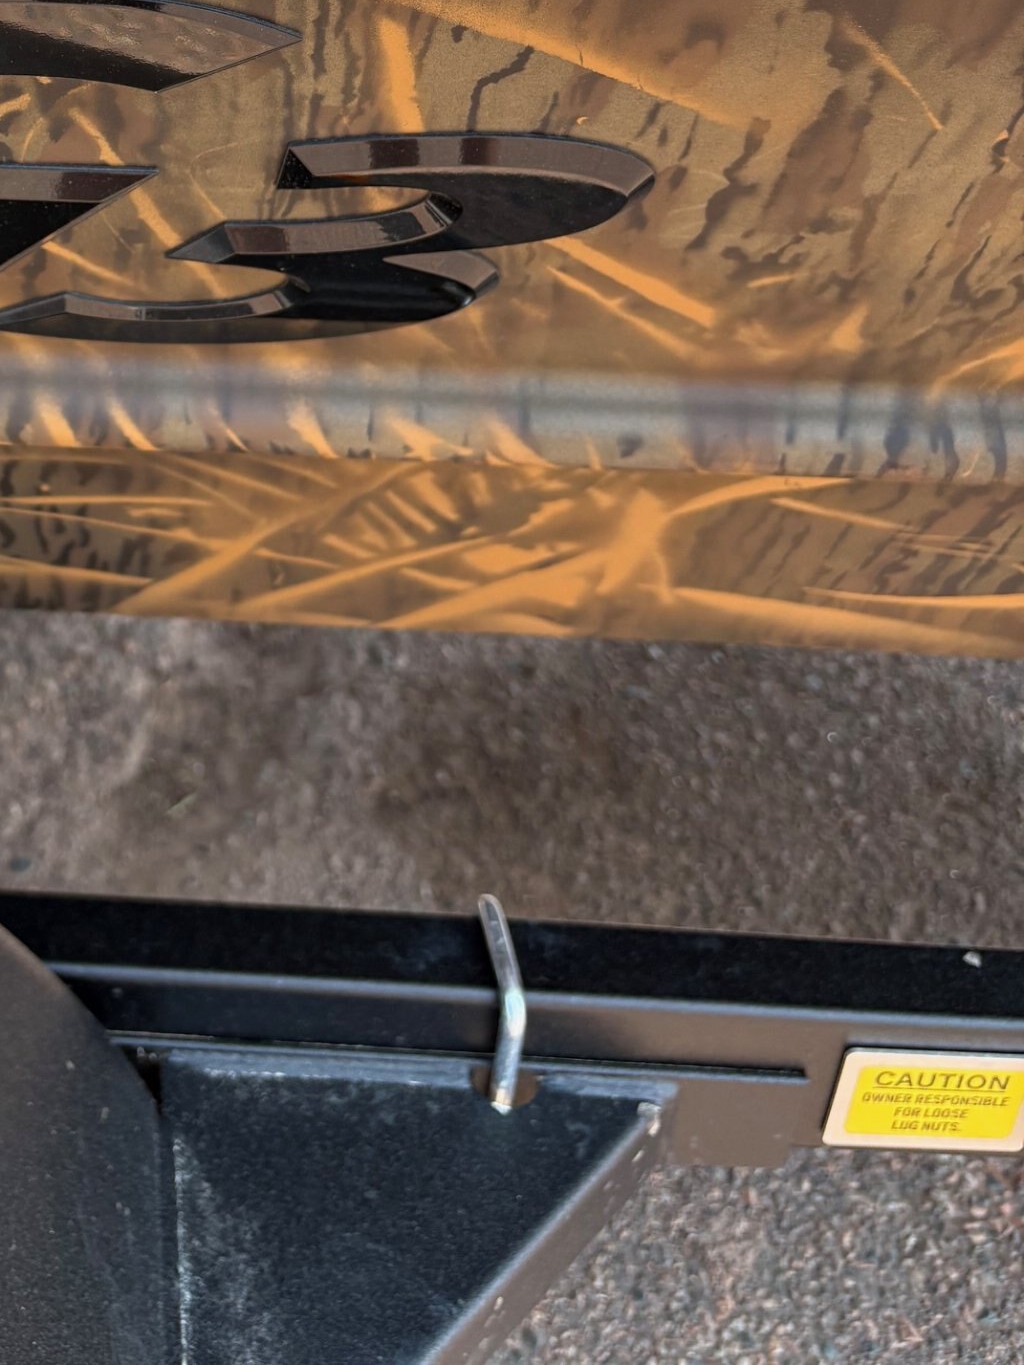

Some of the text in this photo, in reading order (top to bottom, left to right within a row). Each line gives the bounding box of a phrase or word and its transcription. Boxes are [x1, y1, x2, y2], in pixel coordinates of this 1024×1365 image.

[875, 1070, 1011, 1090] CAUTION
[861, 1091, 1012, 1107] OWNER RESPONSIBLE
[893, 1106, 970, 1119] FOR LOOSE
[891, 1120, 920, 1131] LUG
